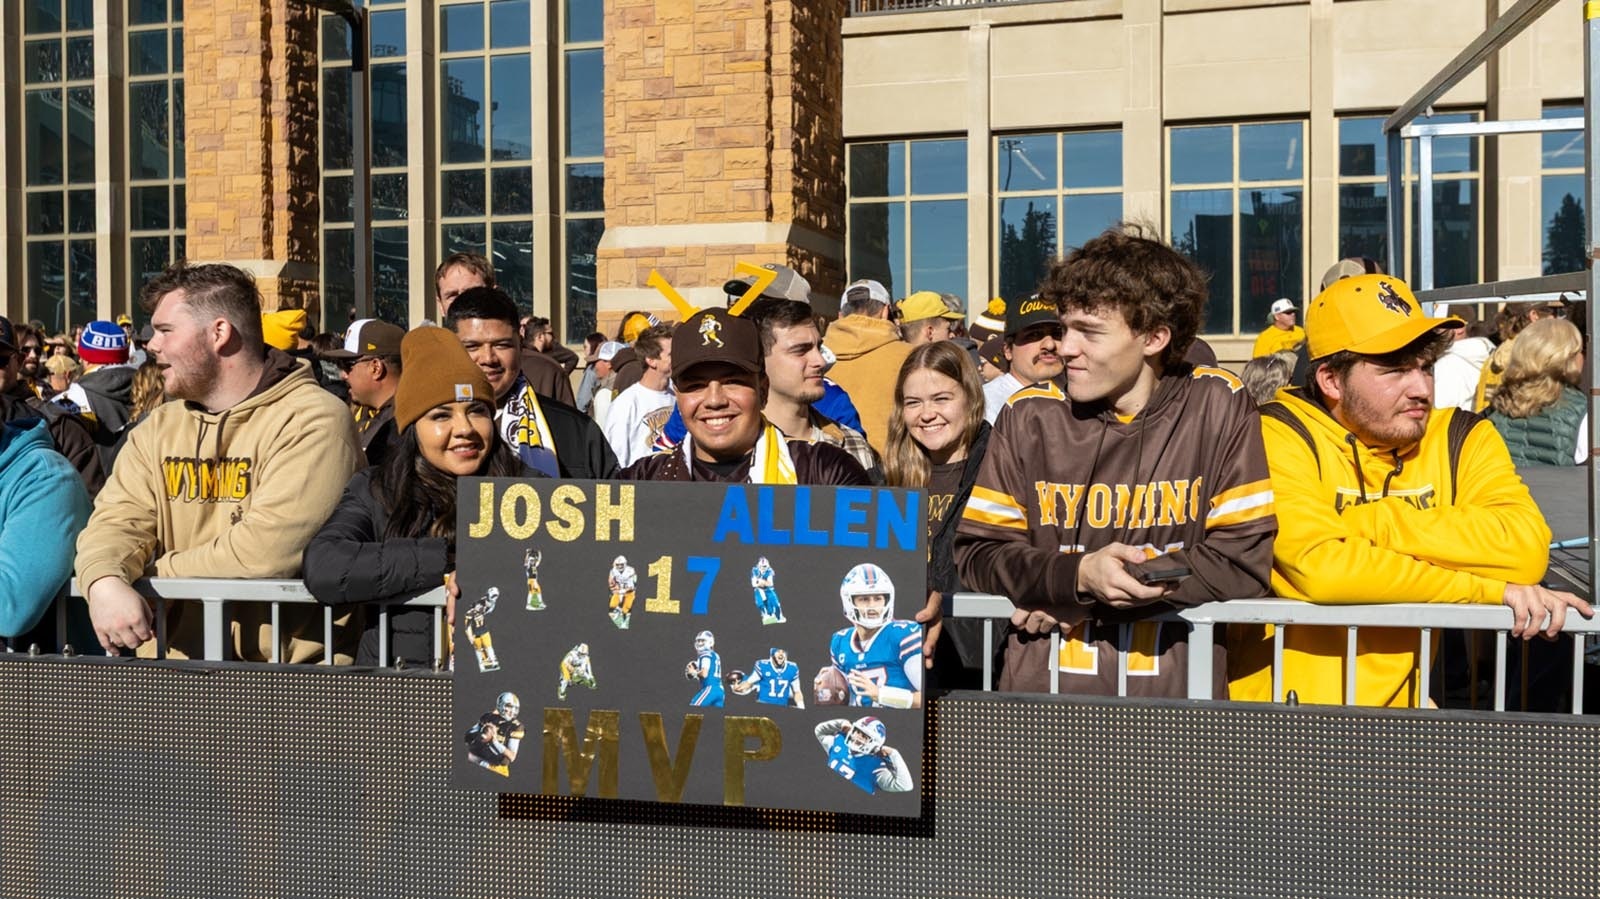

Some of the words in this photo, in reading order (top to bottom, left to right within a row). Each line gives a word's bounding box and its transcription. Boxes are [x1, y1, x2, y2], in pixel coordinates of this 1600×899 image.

[162, 457, 251, 501] WYMING
[468, 482, 636, 542] JOSH
[713, 486, 921, 551] ALLEN
[645, 555, 722, 616] 17
[769, 679, 788, 697] 17
[542, 709, 781, 806] MVP
